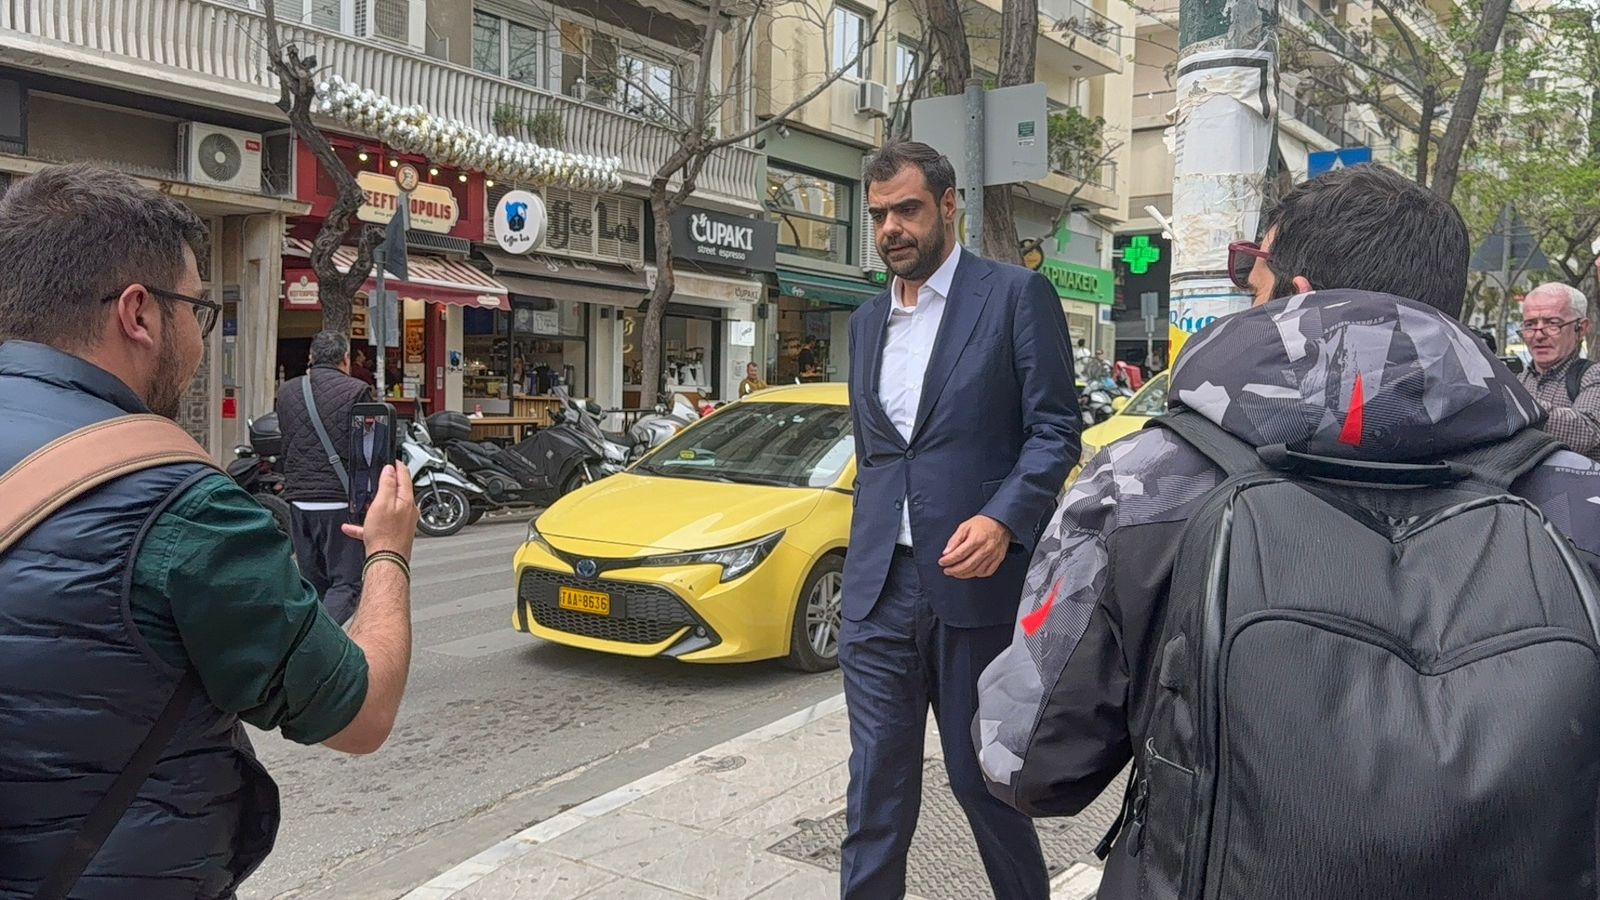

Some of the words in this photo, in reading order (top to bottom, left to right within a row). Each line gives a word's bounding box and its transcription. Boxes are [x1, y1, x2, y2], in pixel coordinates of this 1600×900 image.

[691, 213, 753, 251] CUPAKI
[697, 245, 717, 256] street
[718, 249, 746, 261] espresso
[1041, 265, 1098, 292] ΑΡΜΑΚΕΙΟ
